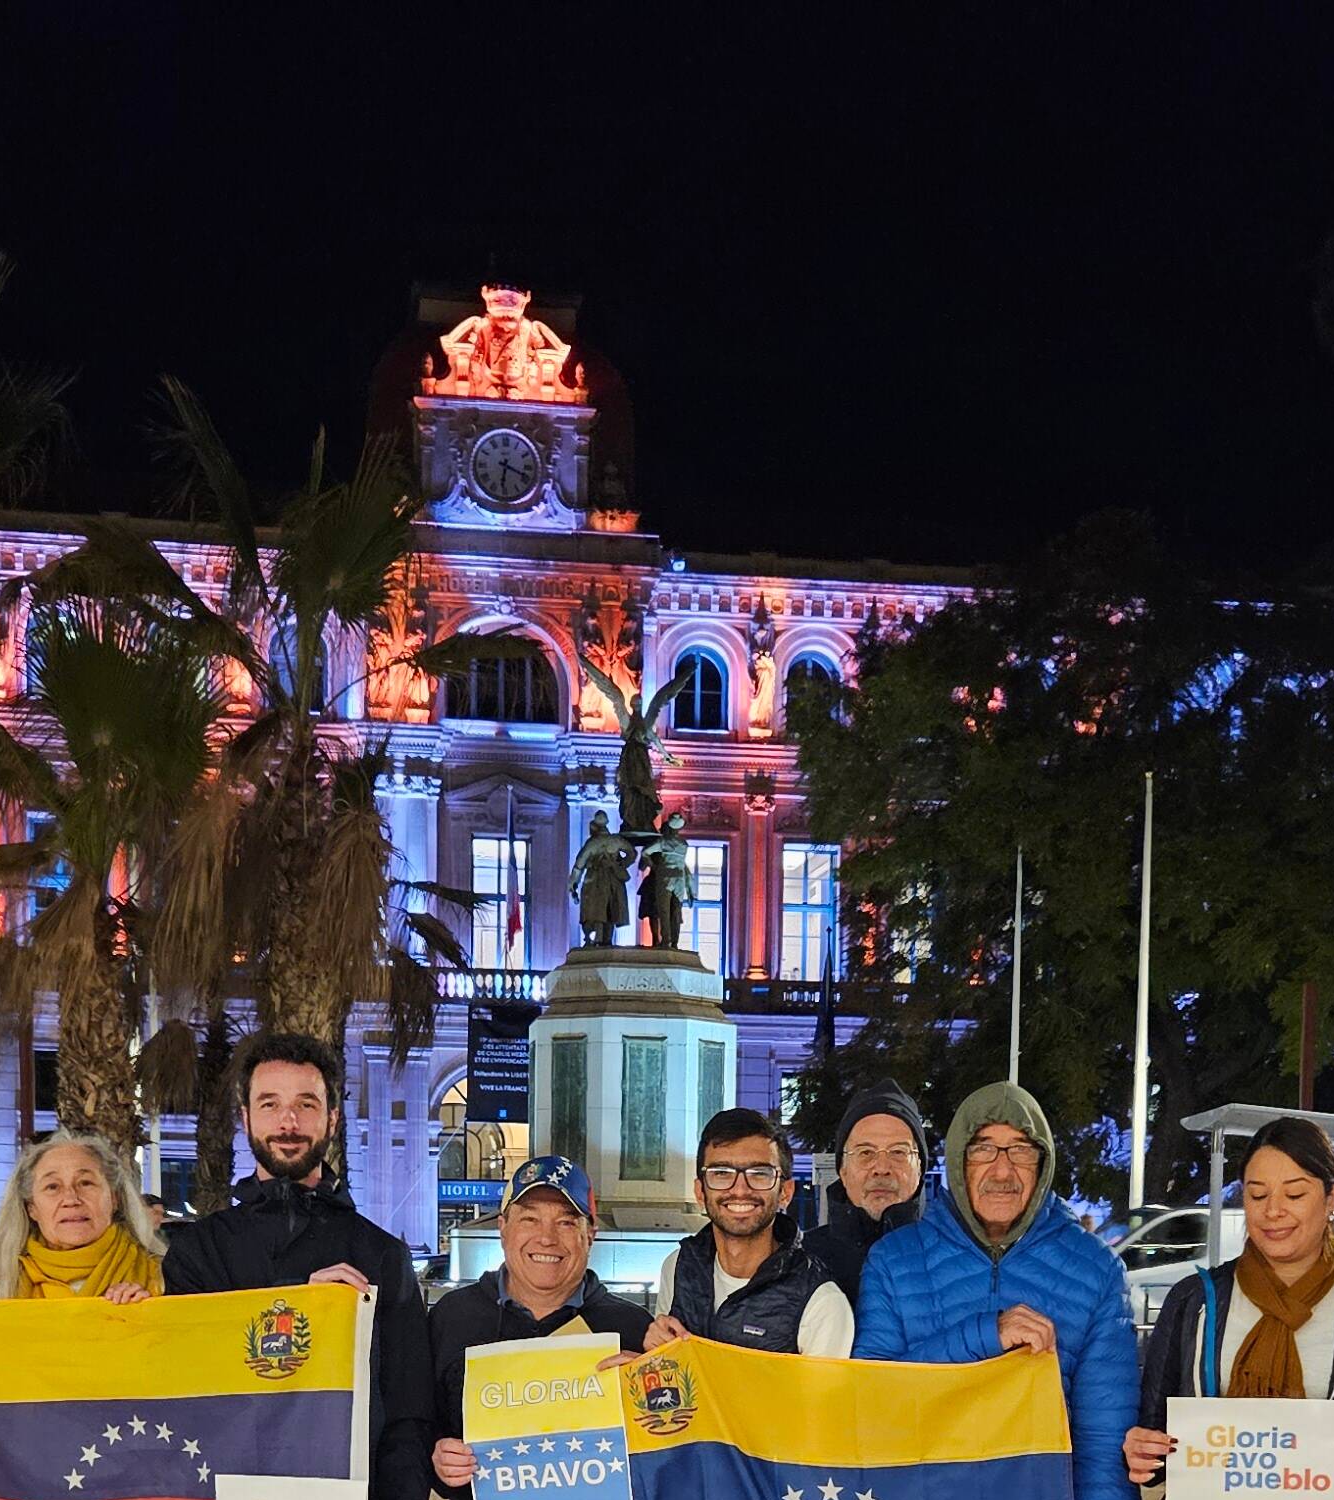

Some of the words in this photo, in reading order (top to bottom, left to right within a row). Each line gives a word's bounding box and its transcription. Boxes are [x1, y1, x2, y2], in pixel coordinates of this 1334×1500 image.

[442, 1184, 489, 1196] HOTEL
[480, 1375, 604, 1409] GLORIA
[1206, 1425, 1298, 1449] Gloria
[1186, 1446, 1277, 1470] bravo
[495, 1458, 606, 1492] BRAVO
[1224, 1467, 1331, 1492] pueblo
